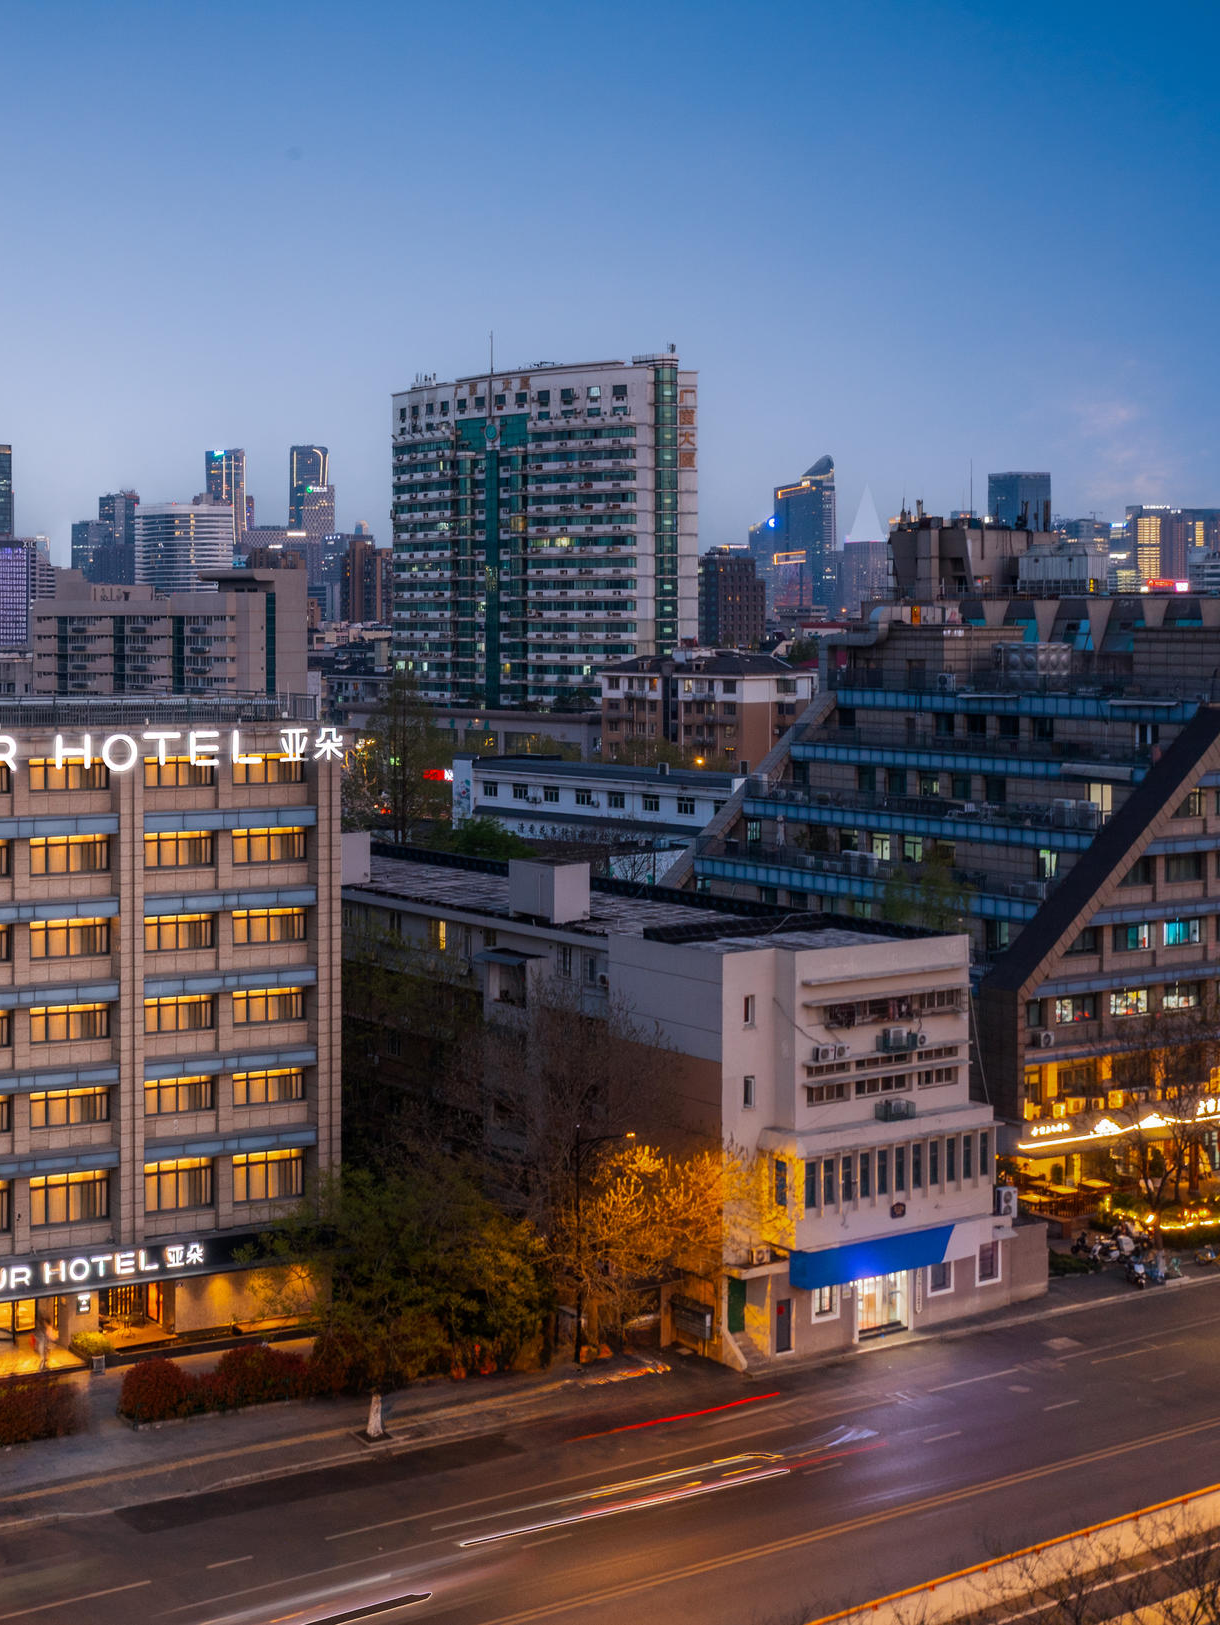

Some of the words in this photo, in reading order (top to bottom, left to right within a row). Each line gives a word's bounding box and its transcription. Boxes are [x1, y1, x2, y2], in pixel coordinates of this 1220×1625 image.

[53, 728, 264, 773] HOTEL
[278, 727, 345, 763] 亚朵
[43, 1249, 160, 1285] HOTEL
[165, 1243, 205, 1269] 亚朵
